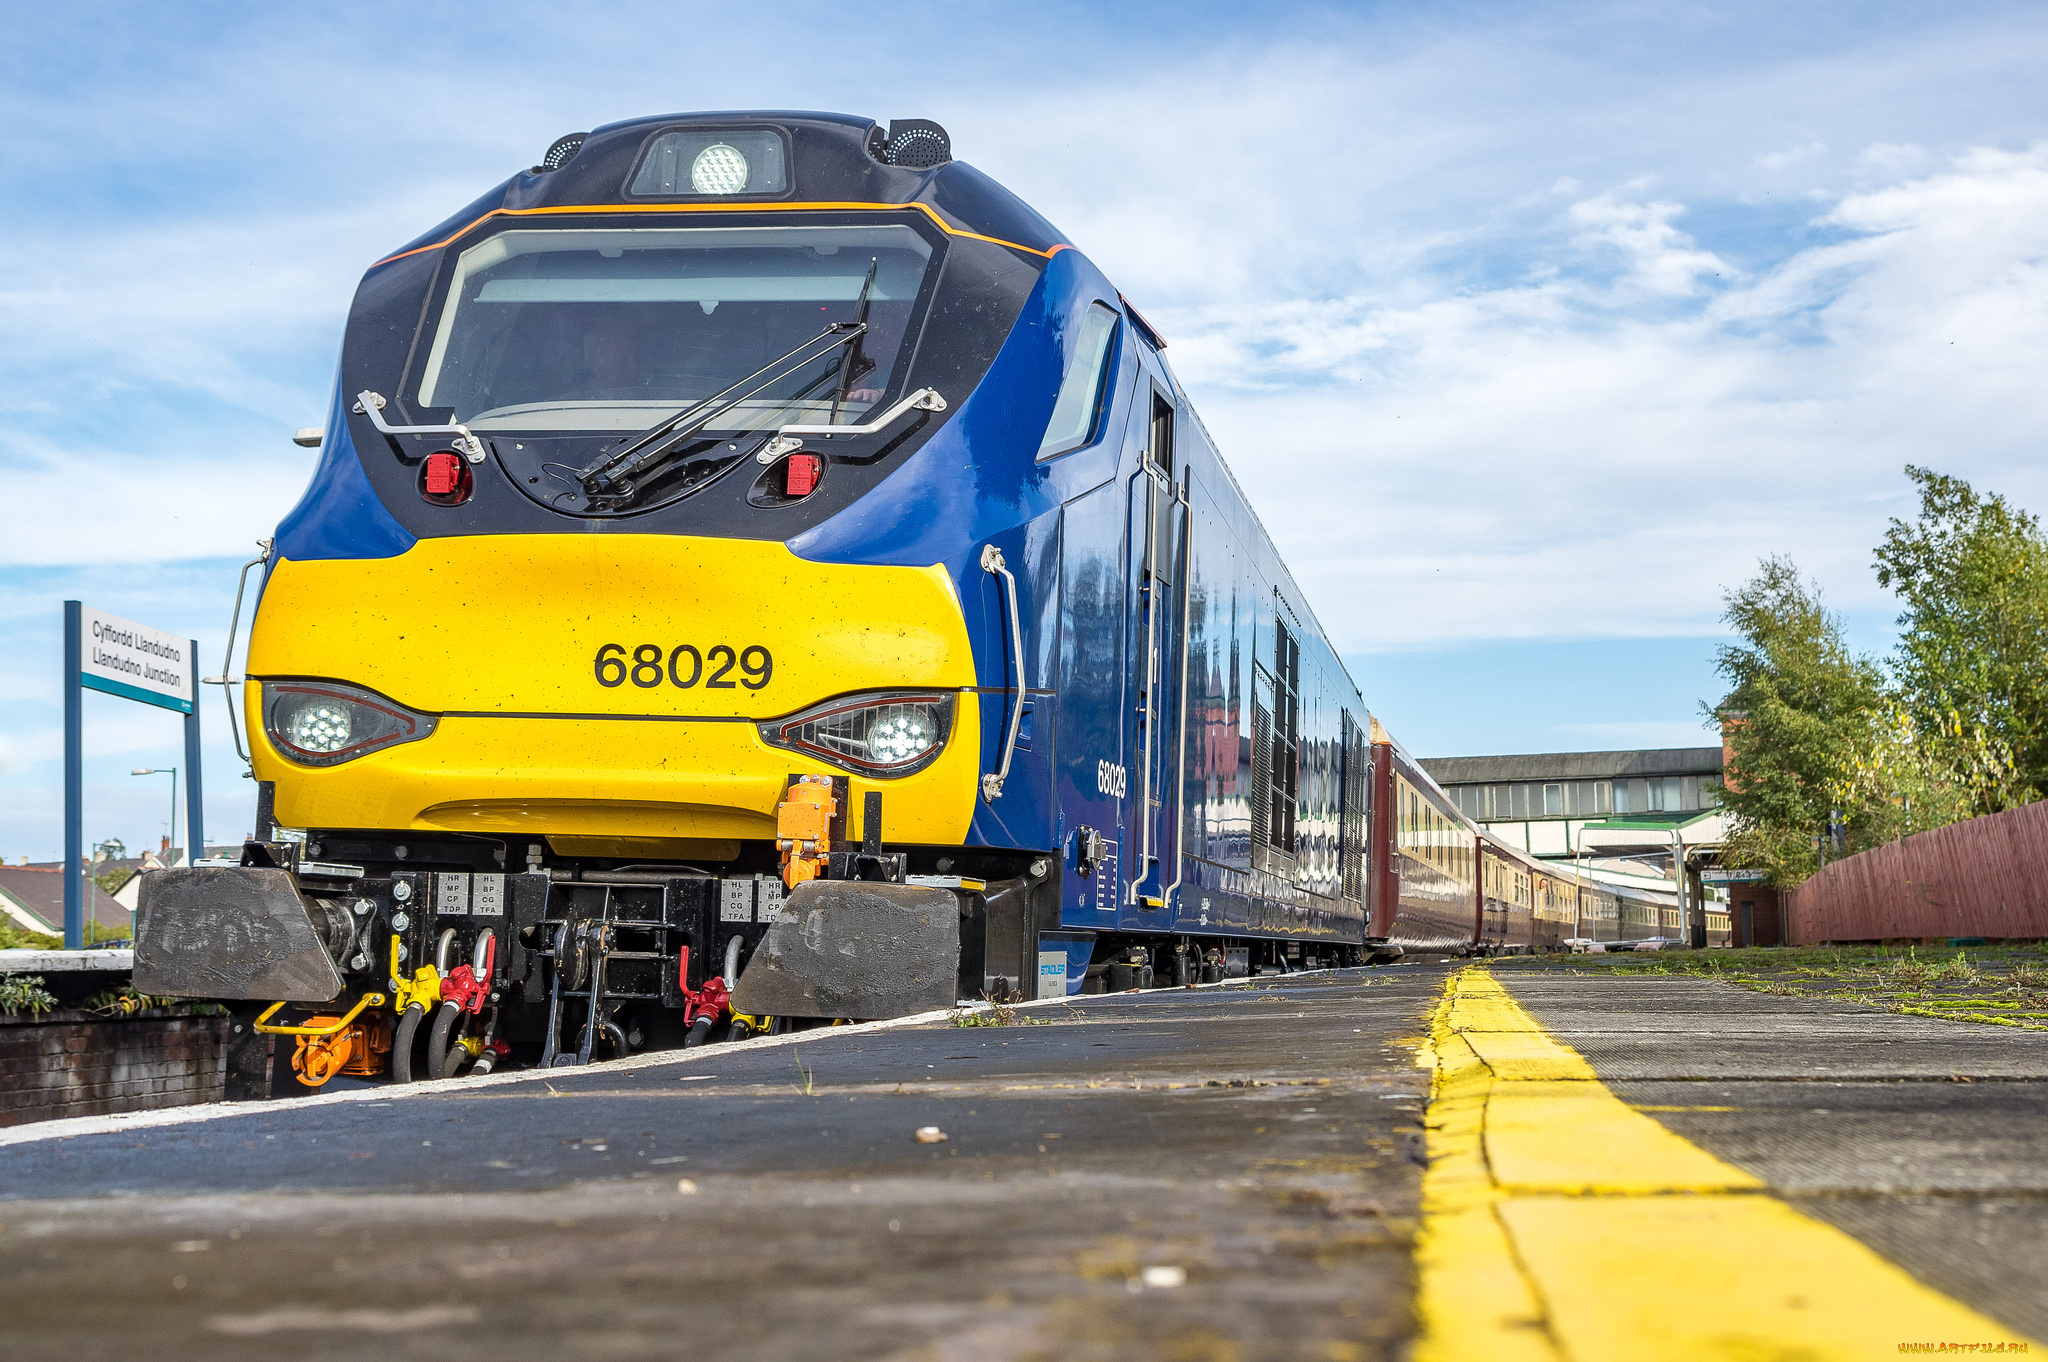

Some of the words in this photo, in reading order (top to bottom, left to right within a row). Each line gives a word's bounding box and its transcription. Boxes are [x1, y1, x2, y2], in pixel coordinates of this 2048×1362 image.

[92, 620, 133, 648] Cyffordd
[135, 632, 180, 663] Llandudno
[93, 646, 142, 676] Llandudno
[143, 662, 181, 688] Junction
[594, 643, 773, 690] 68029
[1097, 758, 1127, 799] 68029
[480, 906, 496, 914] TFA
[730, 902, 743, 910] CG
